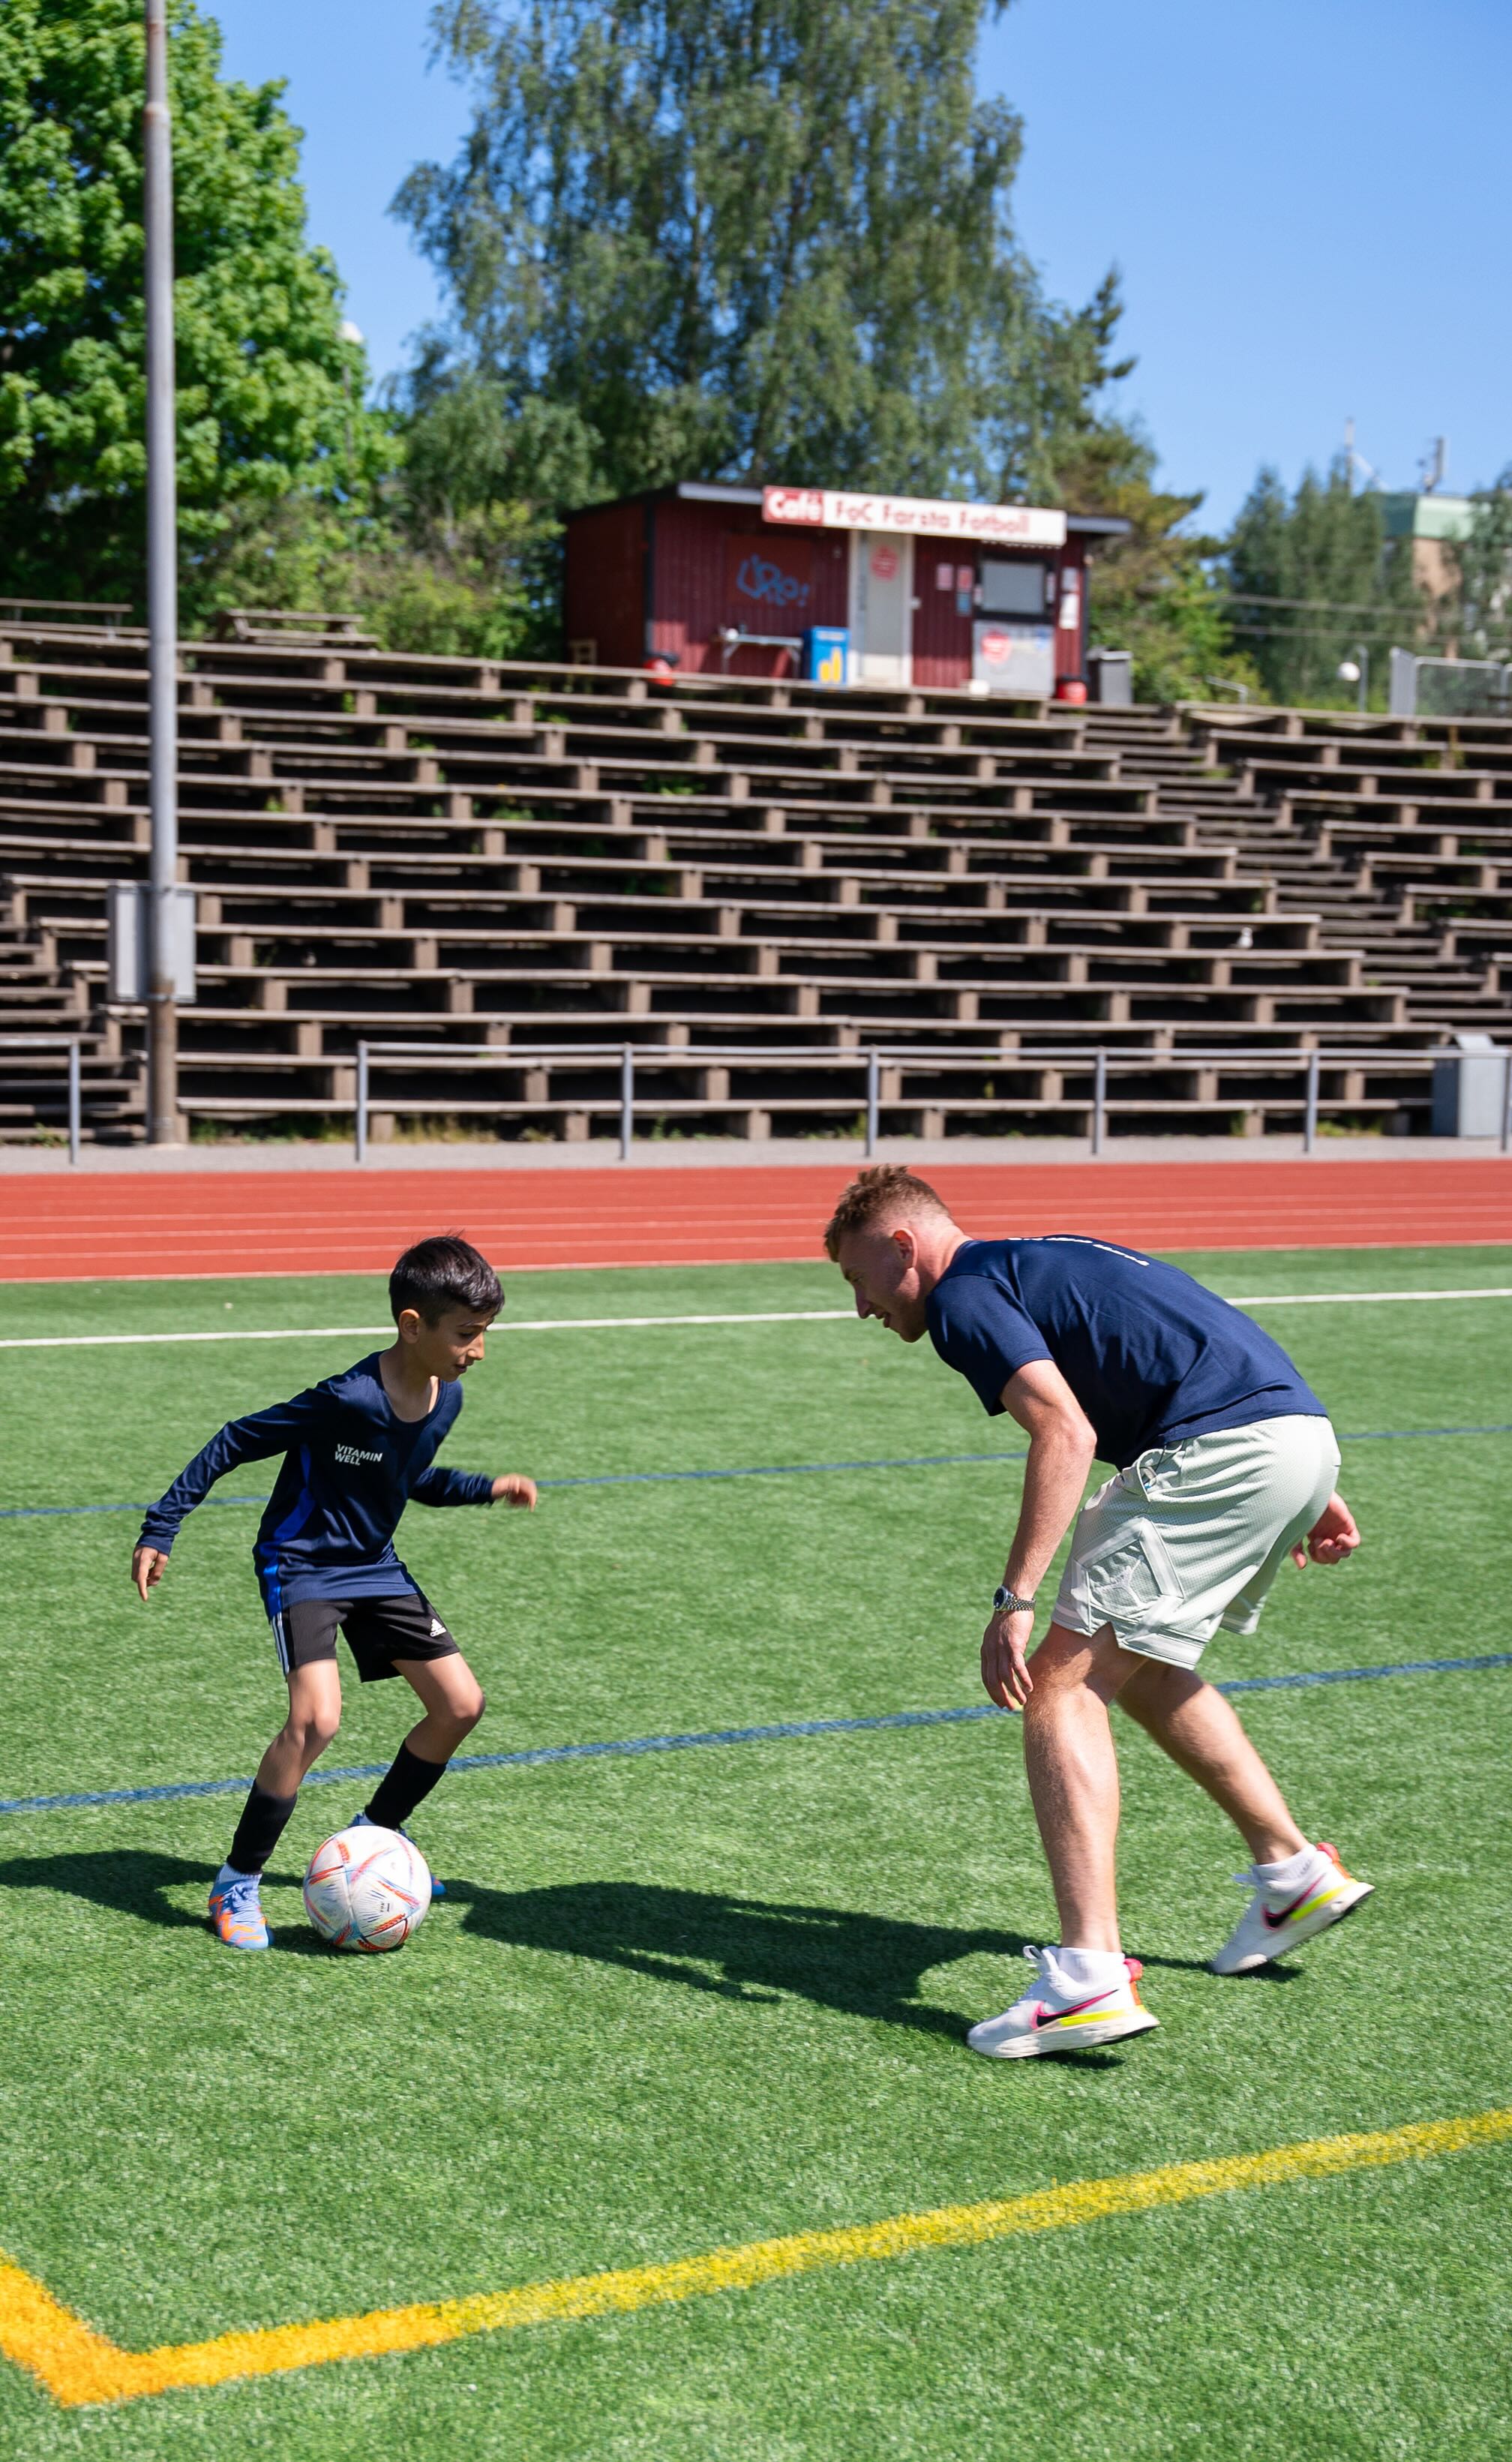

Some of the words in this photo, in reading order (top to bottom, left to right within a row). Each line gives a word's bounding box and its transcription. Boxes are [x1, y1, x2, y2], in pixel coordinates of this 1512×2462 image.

[768, 491, 820, 521] Café
[883, 504, 950, 528] Farsta
[959, 510, 1030, 534] Fotboll
[334, 1451, 361, 1466] WELL
[337, 1443, 382, 1462] VITAMIN
